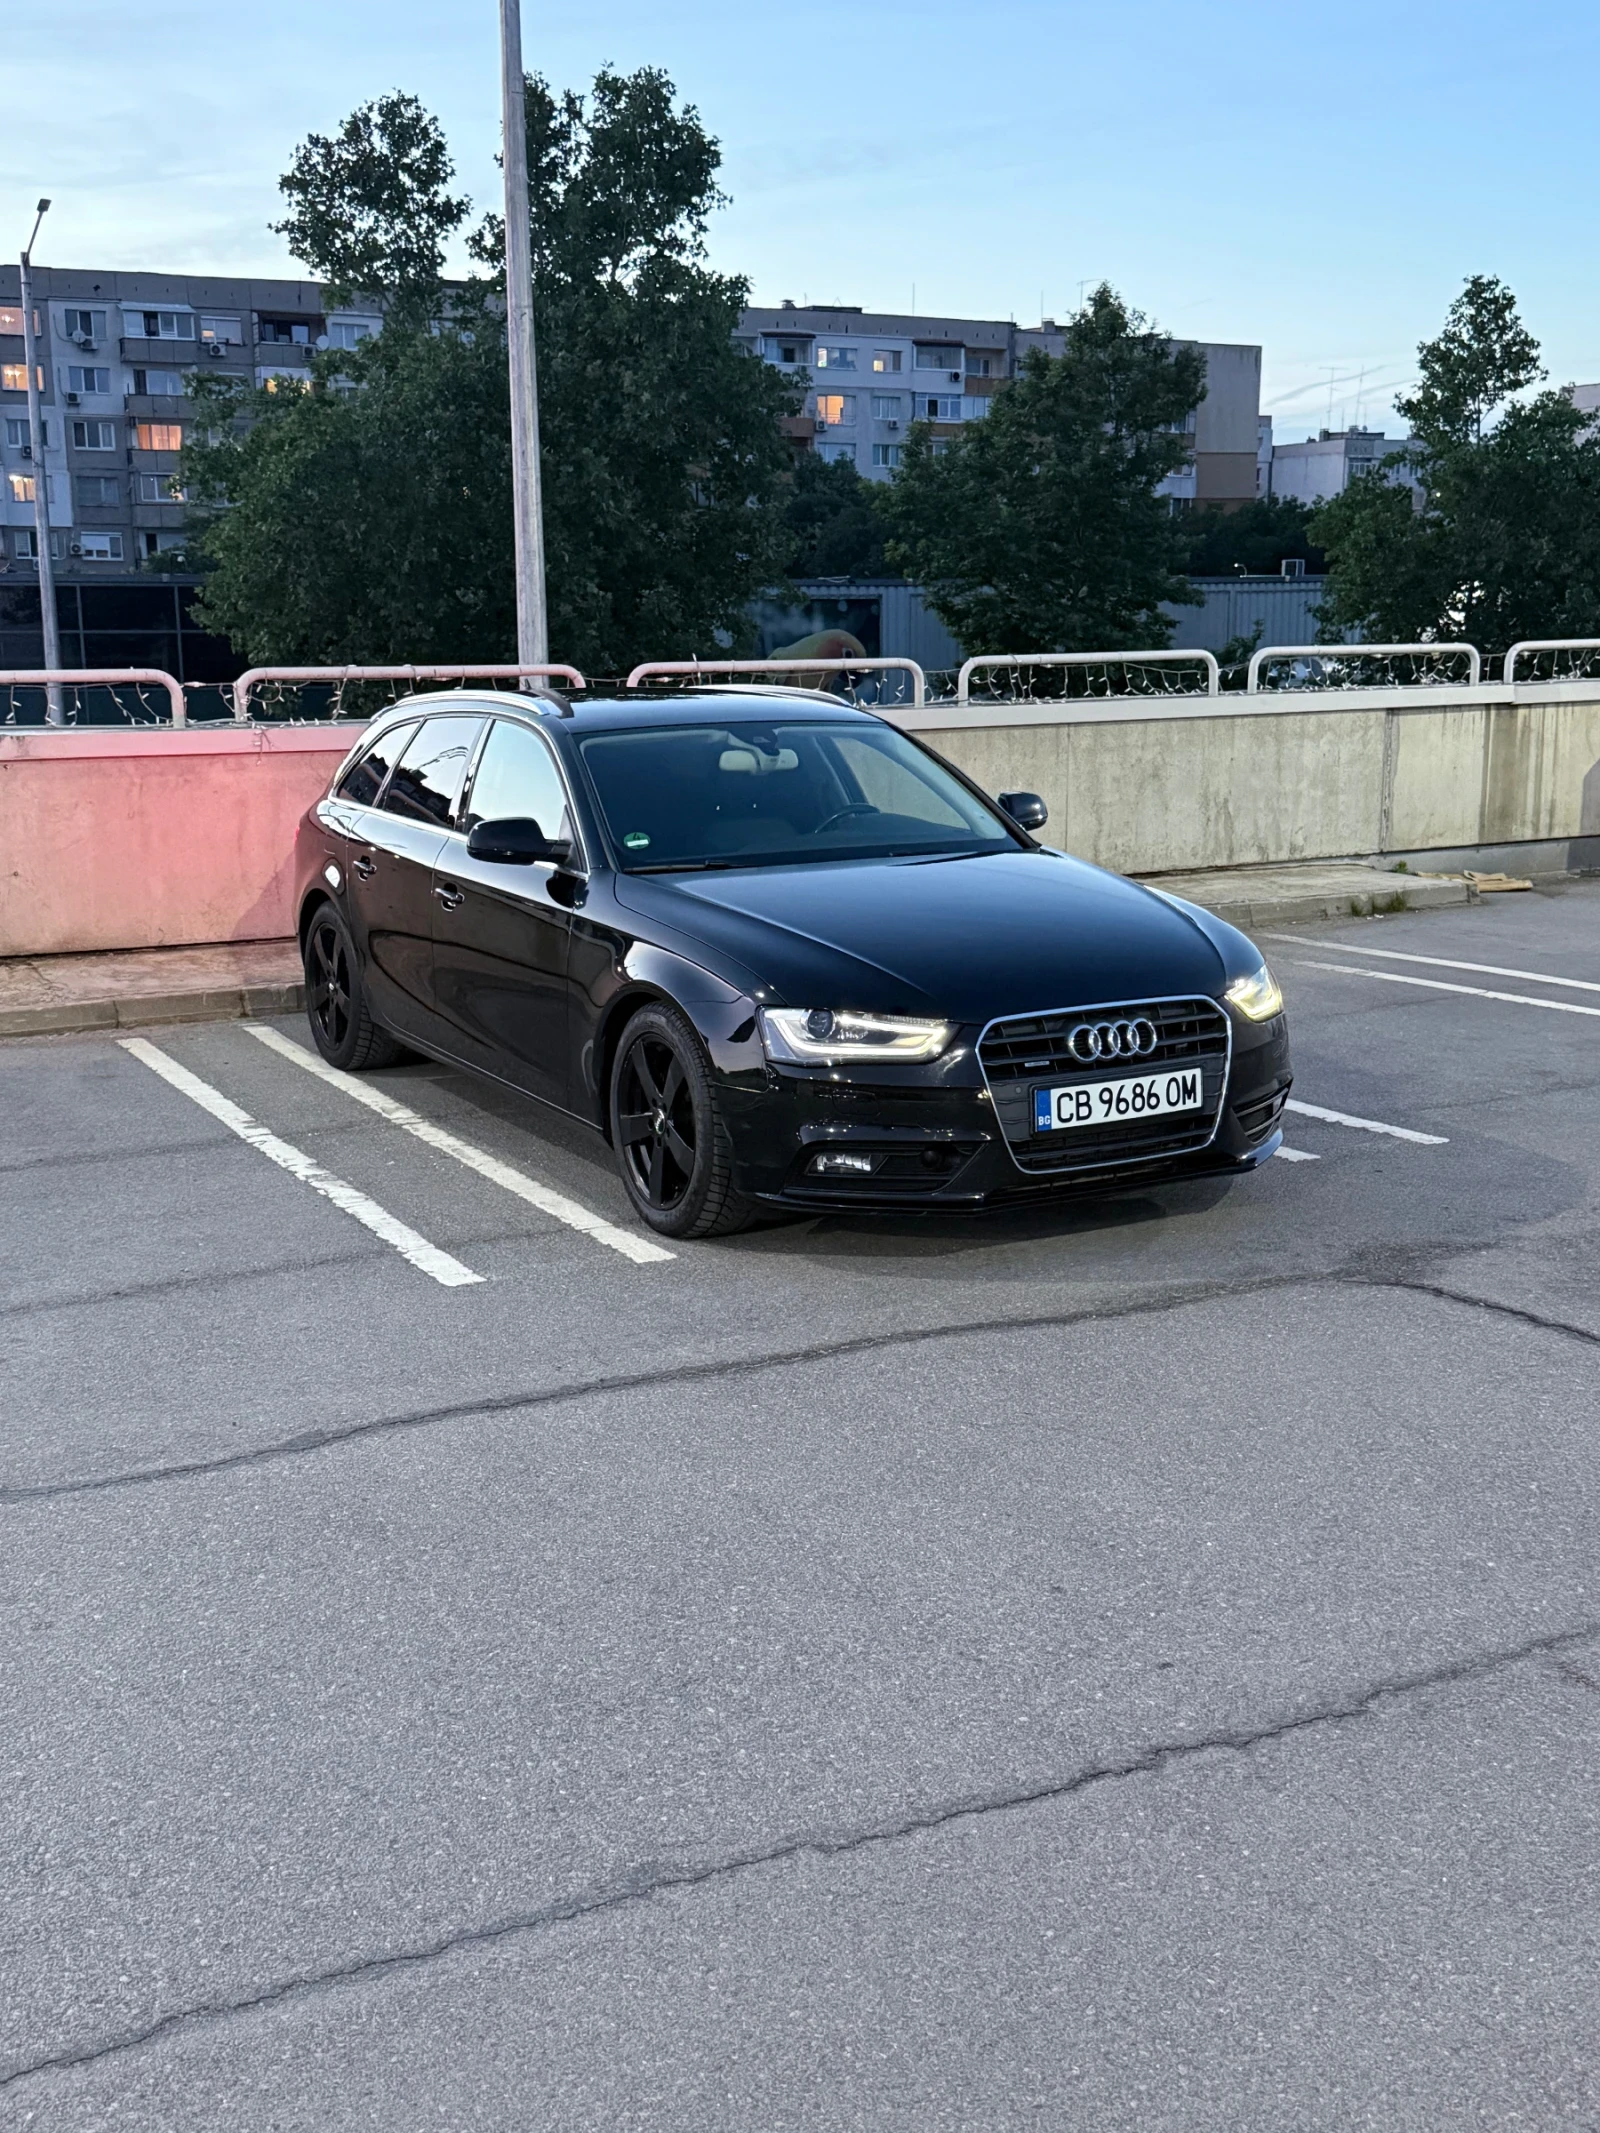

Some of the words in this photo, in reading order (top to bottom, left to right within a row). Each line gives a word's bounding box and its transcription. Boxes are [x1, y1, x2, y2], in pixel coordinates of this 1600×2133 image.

[1056, 1090, 1092, 1123] CB
[1099, 1080, 1160, 1117] 9686
[1166, 1074, 1197, 1107] OM
[1038, 1115, 1051, 1125] BG
